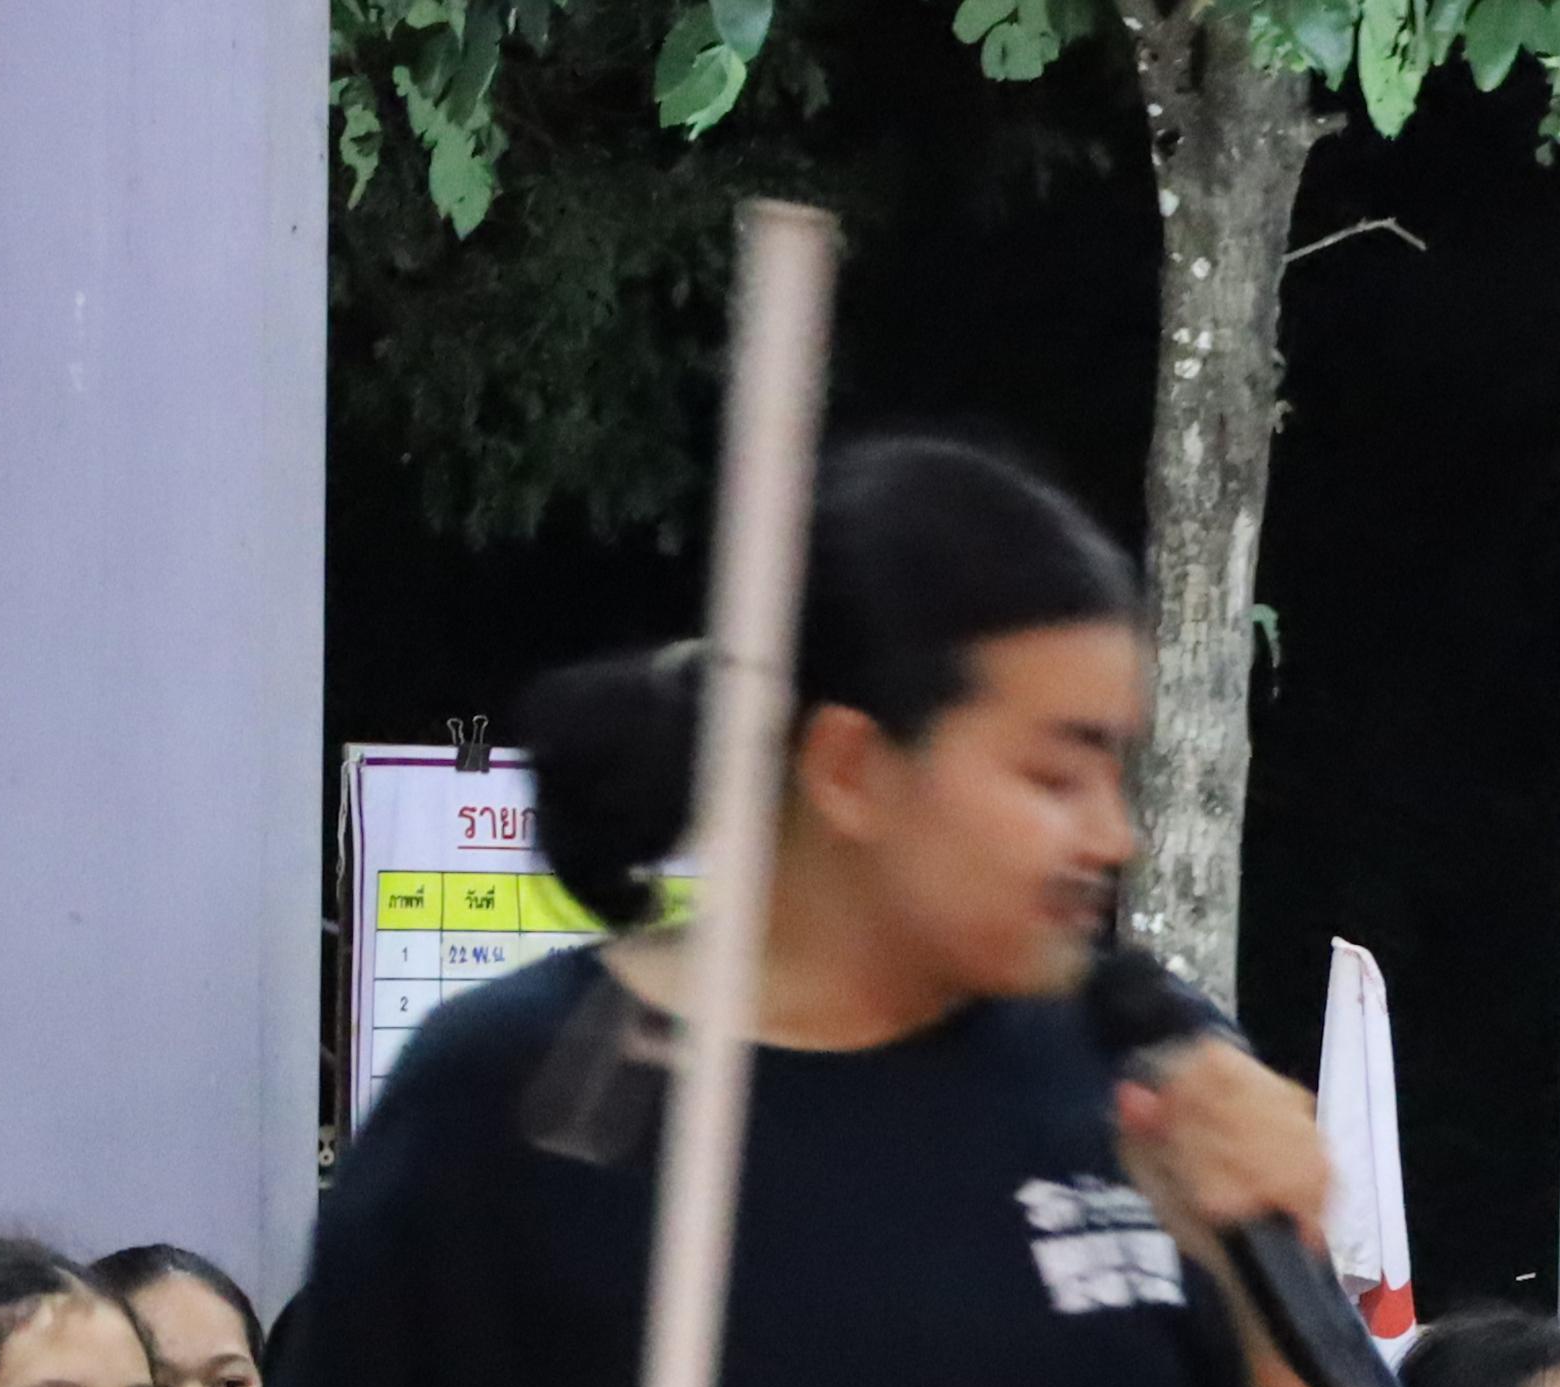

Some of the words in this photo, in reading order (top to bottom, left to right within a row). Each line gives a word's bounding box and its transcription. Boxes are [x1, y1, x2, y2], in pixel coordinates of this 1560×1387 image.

[464, 886, 496, 909] วันที่
[401, 946, 409, 963] 1
[449, 949, 468, 964] 22
[400, 996, 409, 1012] 2
